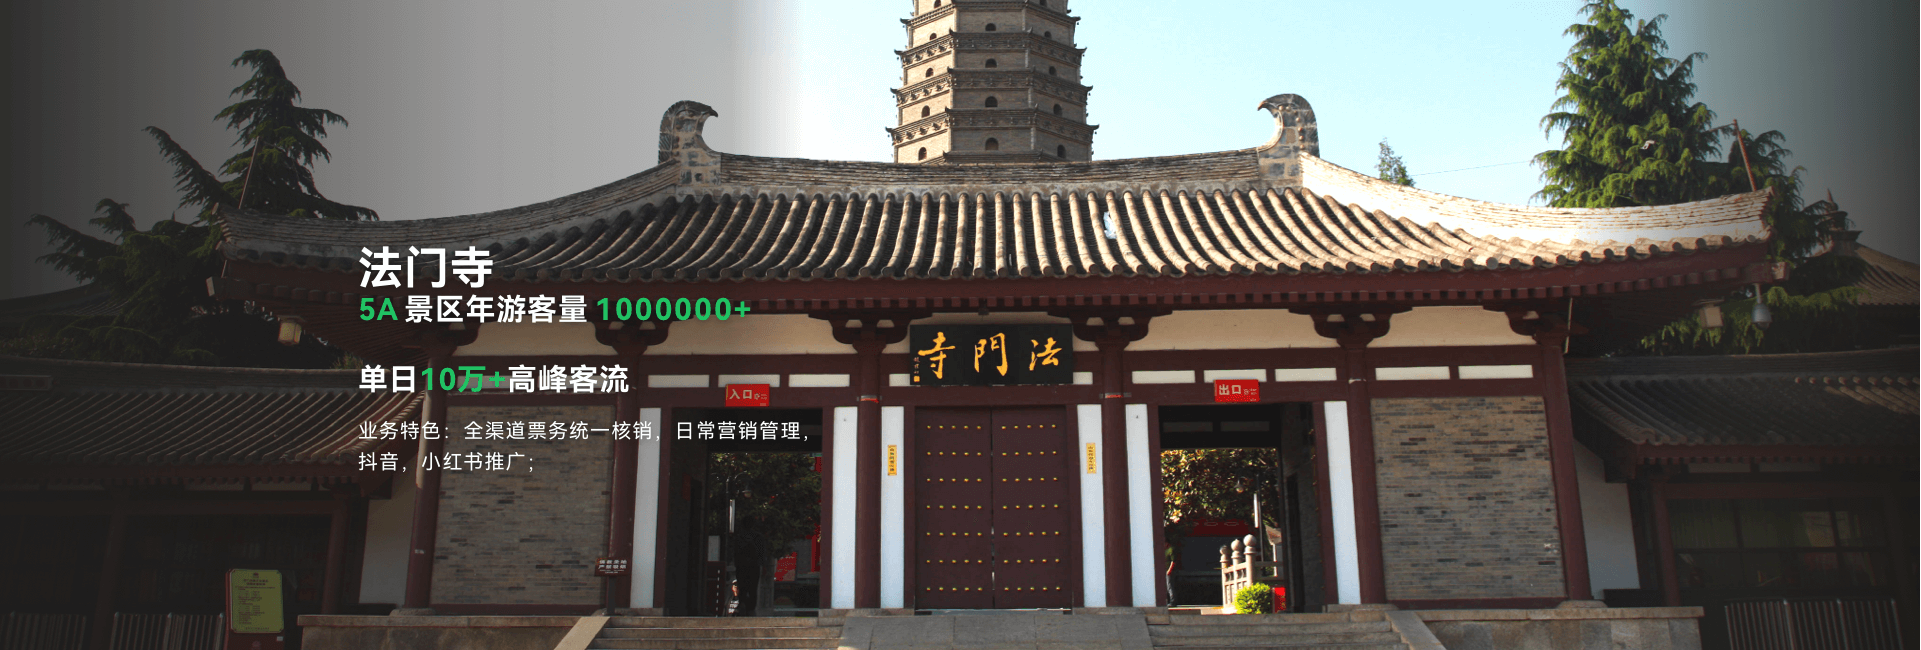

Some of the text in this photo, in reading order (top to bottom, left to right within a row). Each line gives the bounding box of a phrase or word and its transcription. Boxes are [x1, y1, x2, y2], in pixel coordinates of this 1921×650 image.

[918, 331, 1062, 380] 法門寺
[729, 389, 752, 399] 入口
[1219, 384, 1241, 395] 出口
